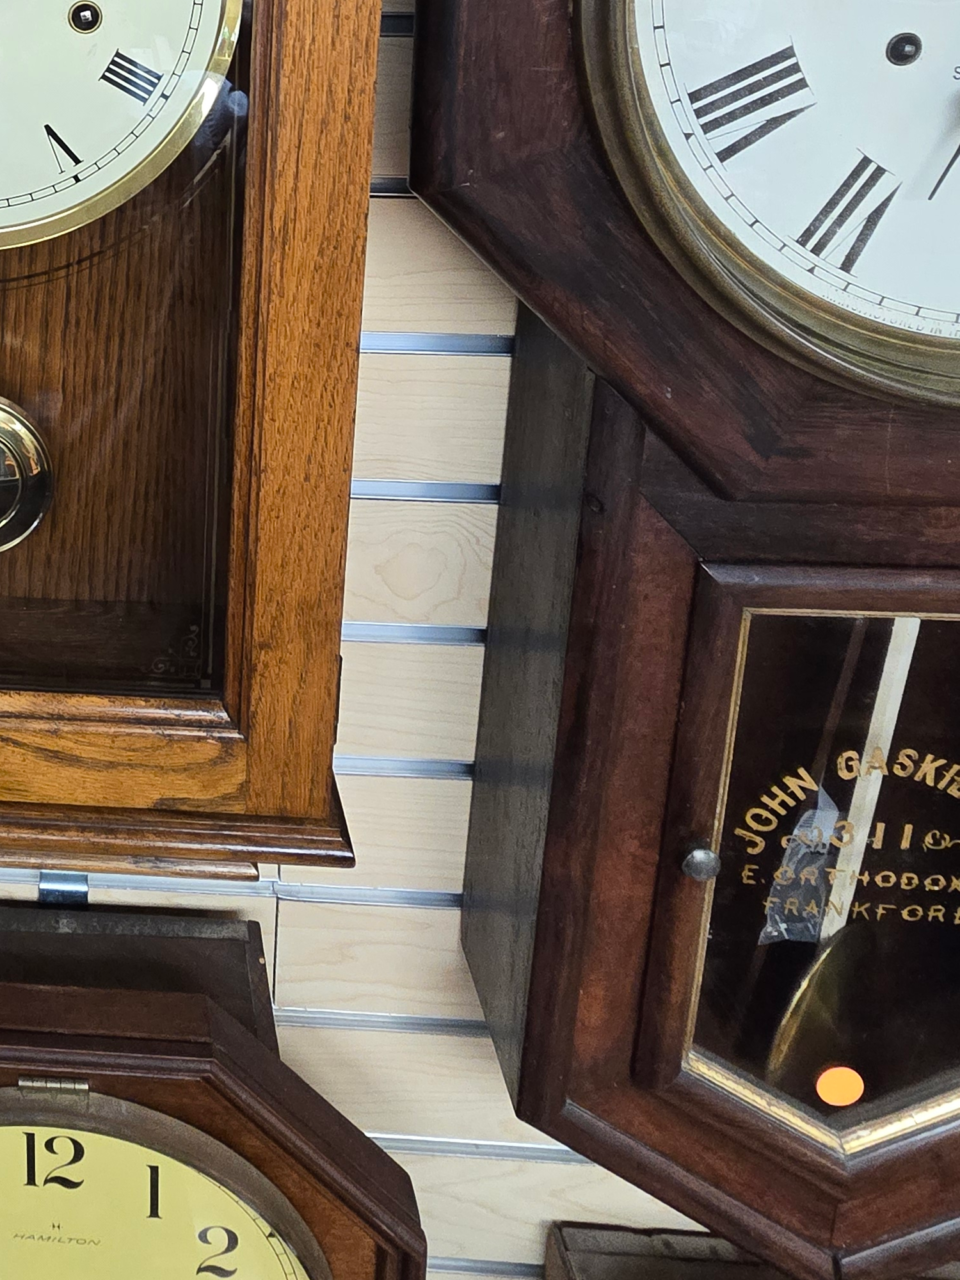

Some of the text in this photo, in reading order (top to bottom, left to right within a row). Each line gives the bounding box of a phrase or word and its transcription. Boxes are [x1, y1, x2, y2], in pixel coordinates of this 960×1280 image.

[683, 35, 818, 172] VIII
[43, 124, 84, 175] V
[787, 147, 903, 278] VII
[734, 766, 820, 855] JOHN
[22, 1131, 85, 1189] 12
[146, 1164, 162, 1219] 1
[13, 1233, 101, 1246] HAMILTON
[195, 1225, 239, 1276] 2
